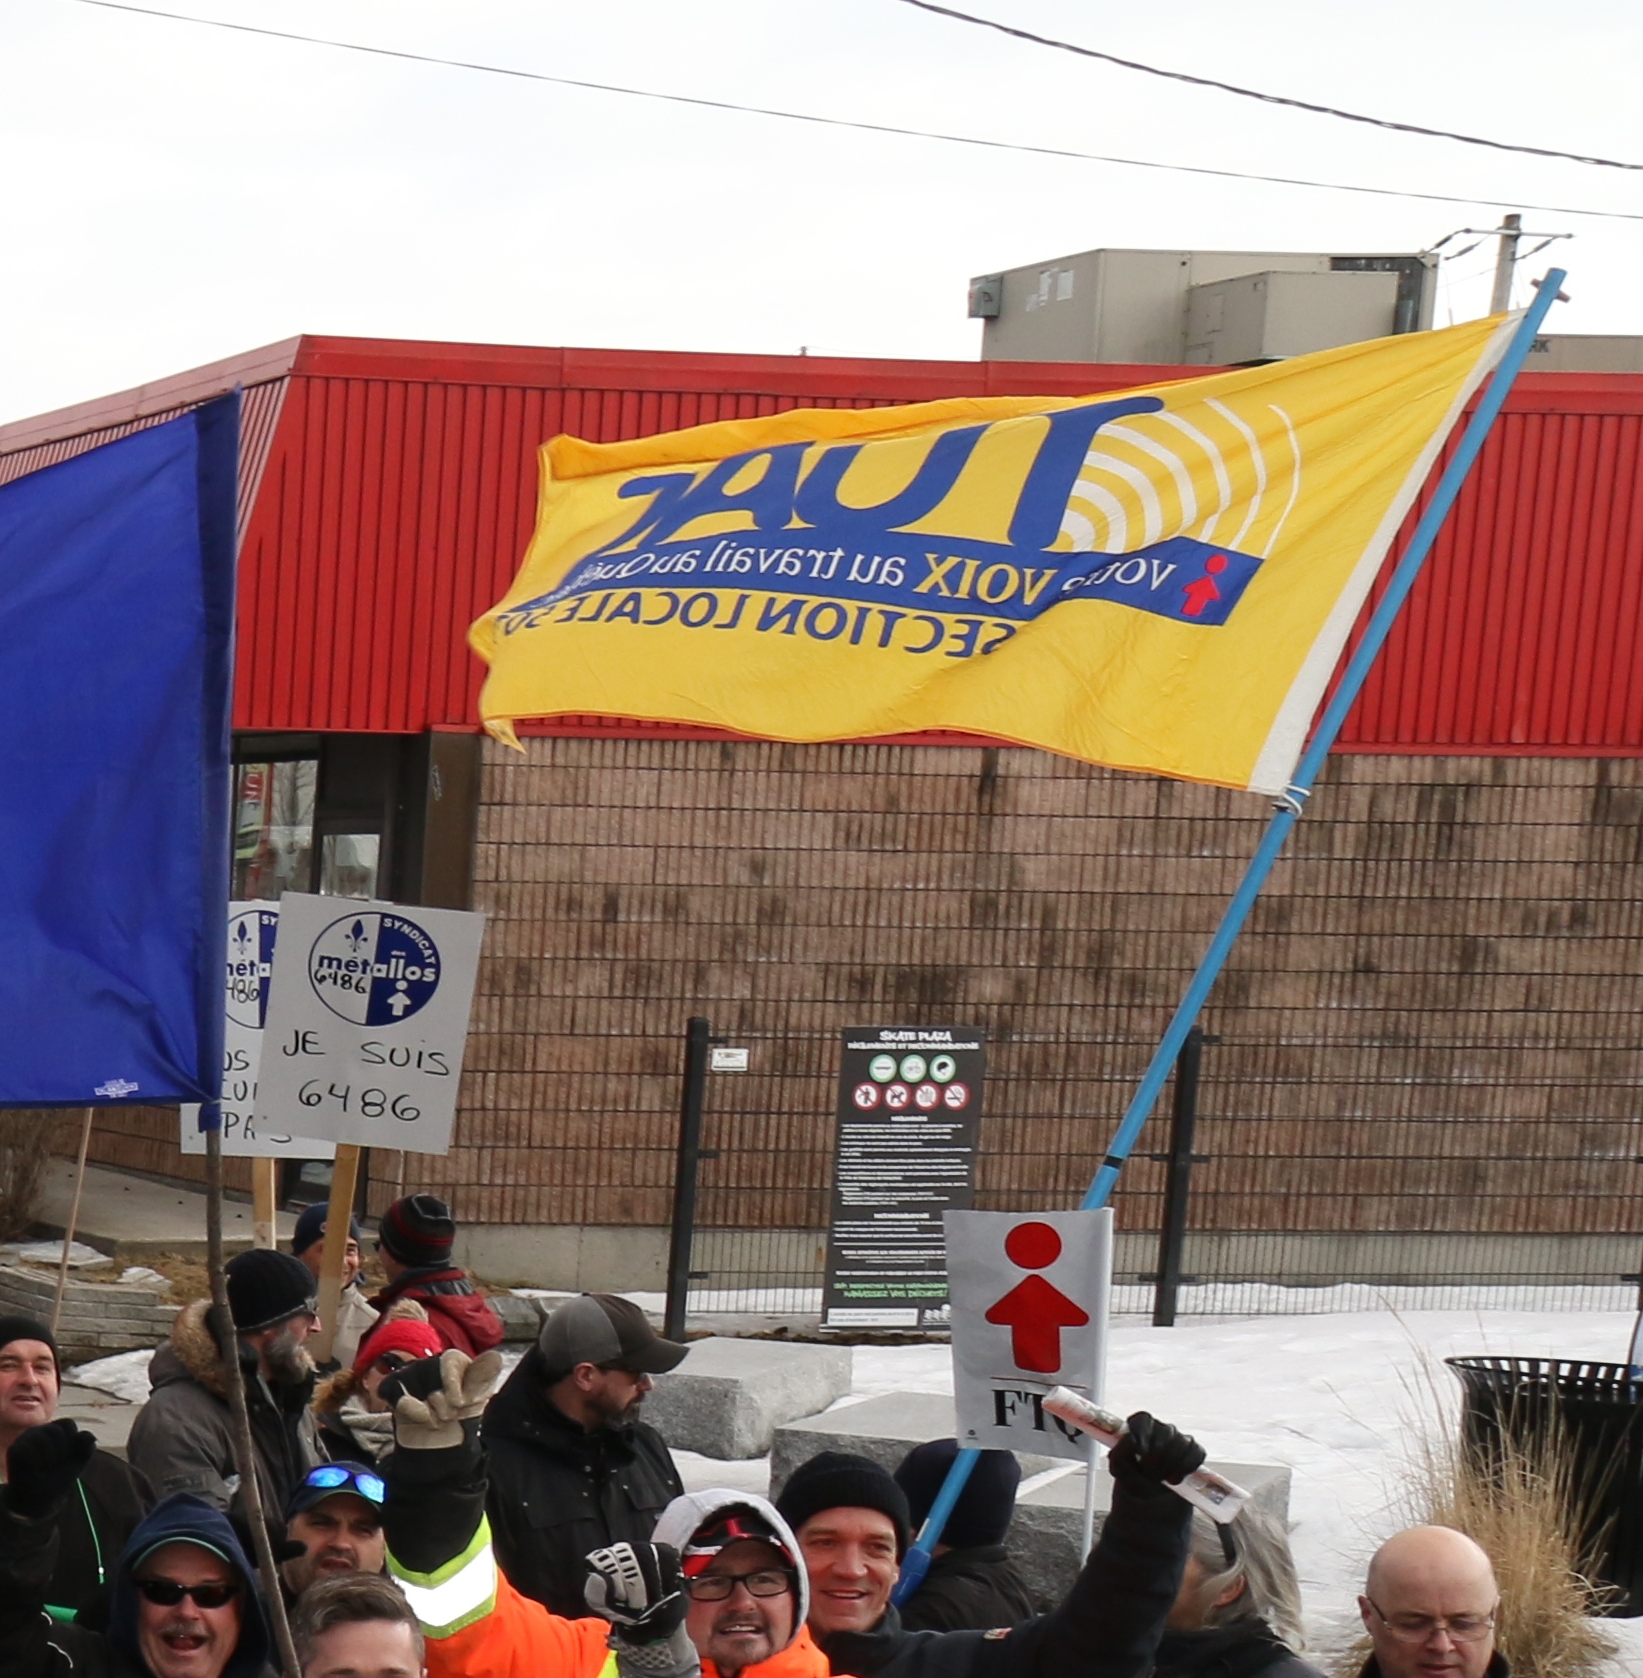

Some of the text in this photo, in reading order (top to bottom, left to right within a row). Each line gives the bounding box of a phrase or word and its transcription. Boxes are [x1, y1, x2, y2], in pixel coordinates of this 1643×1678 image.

[383, 918, 436, 964] SYNDICAT
[313, 968, 368, 995] 6486
[318, 955, 438, 983] métallos
[225, 977, 260, 1003] 486
[282, 1029, 326, 1057] JE
[298, 1079, 421, 1121] 6486
